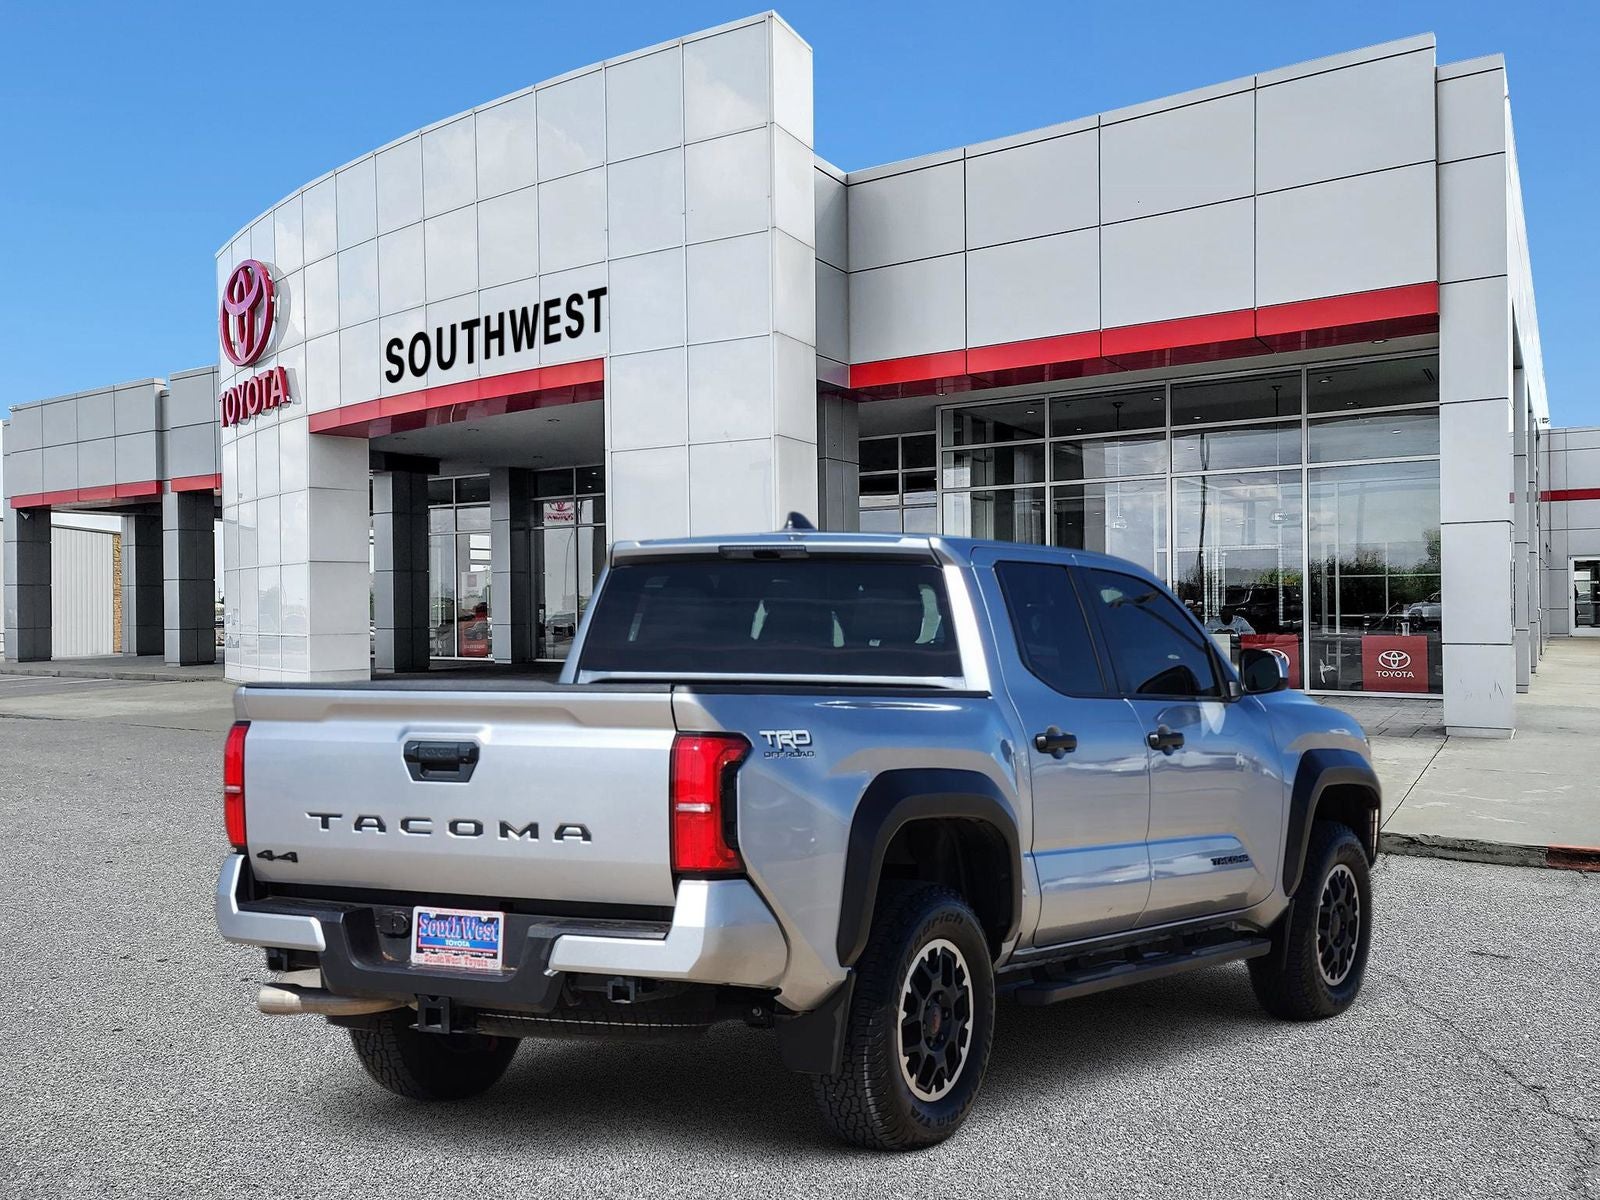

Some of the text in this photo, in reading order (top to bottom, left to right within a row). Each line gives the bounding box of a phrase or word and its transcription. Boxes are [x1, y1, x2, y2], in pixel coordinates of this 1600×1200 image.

[385, 286, 608, 384] SOUTHWEST
[219, 366, 291, 428] TOYOTA
[1376, 670, 1415, 678] TOYOTA
[759, 729, 811, 750] TRD
[304, 811, 593, 844] TACOMA
[1210, 853, 1249, 866] TACOMA
